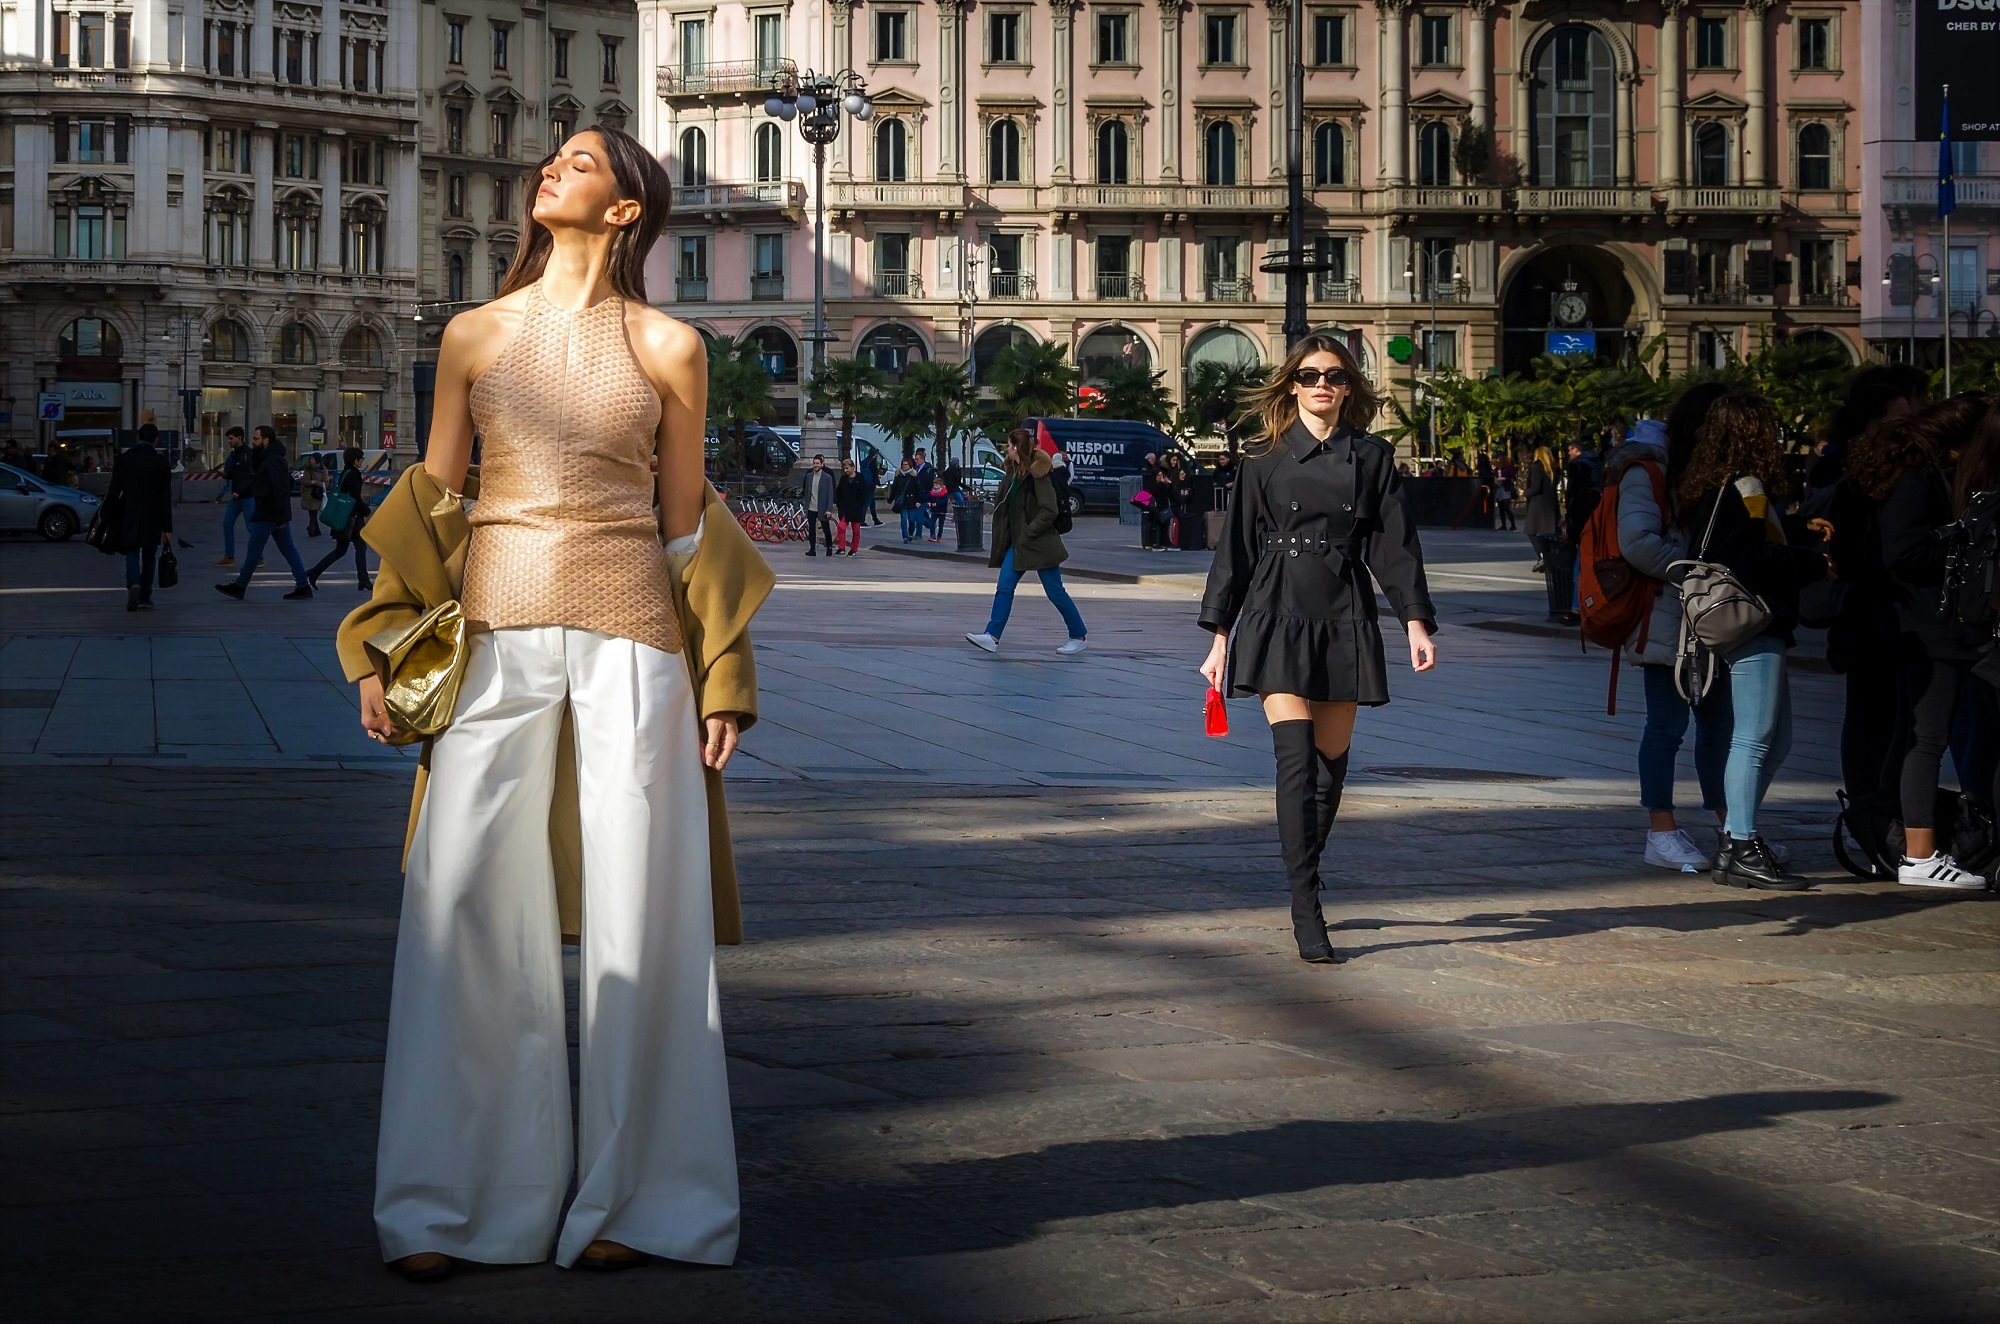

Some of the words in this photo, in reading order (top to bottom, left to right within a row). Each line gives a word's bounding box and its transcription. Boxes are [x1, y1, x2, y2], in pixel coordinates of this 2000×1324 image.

[1946, 22, 1978, 31] CHER
[1980, 22, 1996, 31] BY
[1961, 123, 1987, 131] SHOP
[72, 389, 105, 400] ZARA
[1066, 441, 1125, 454] NESPOLI
[1066, 454, 1103, 466] VIVAI
